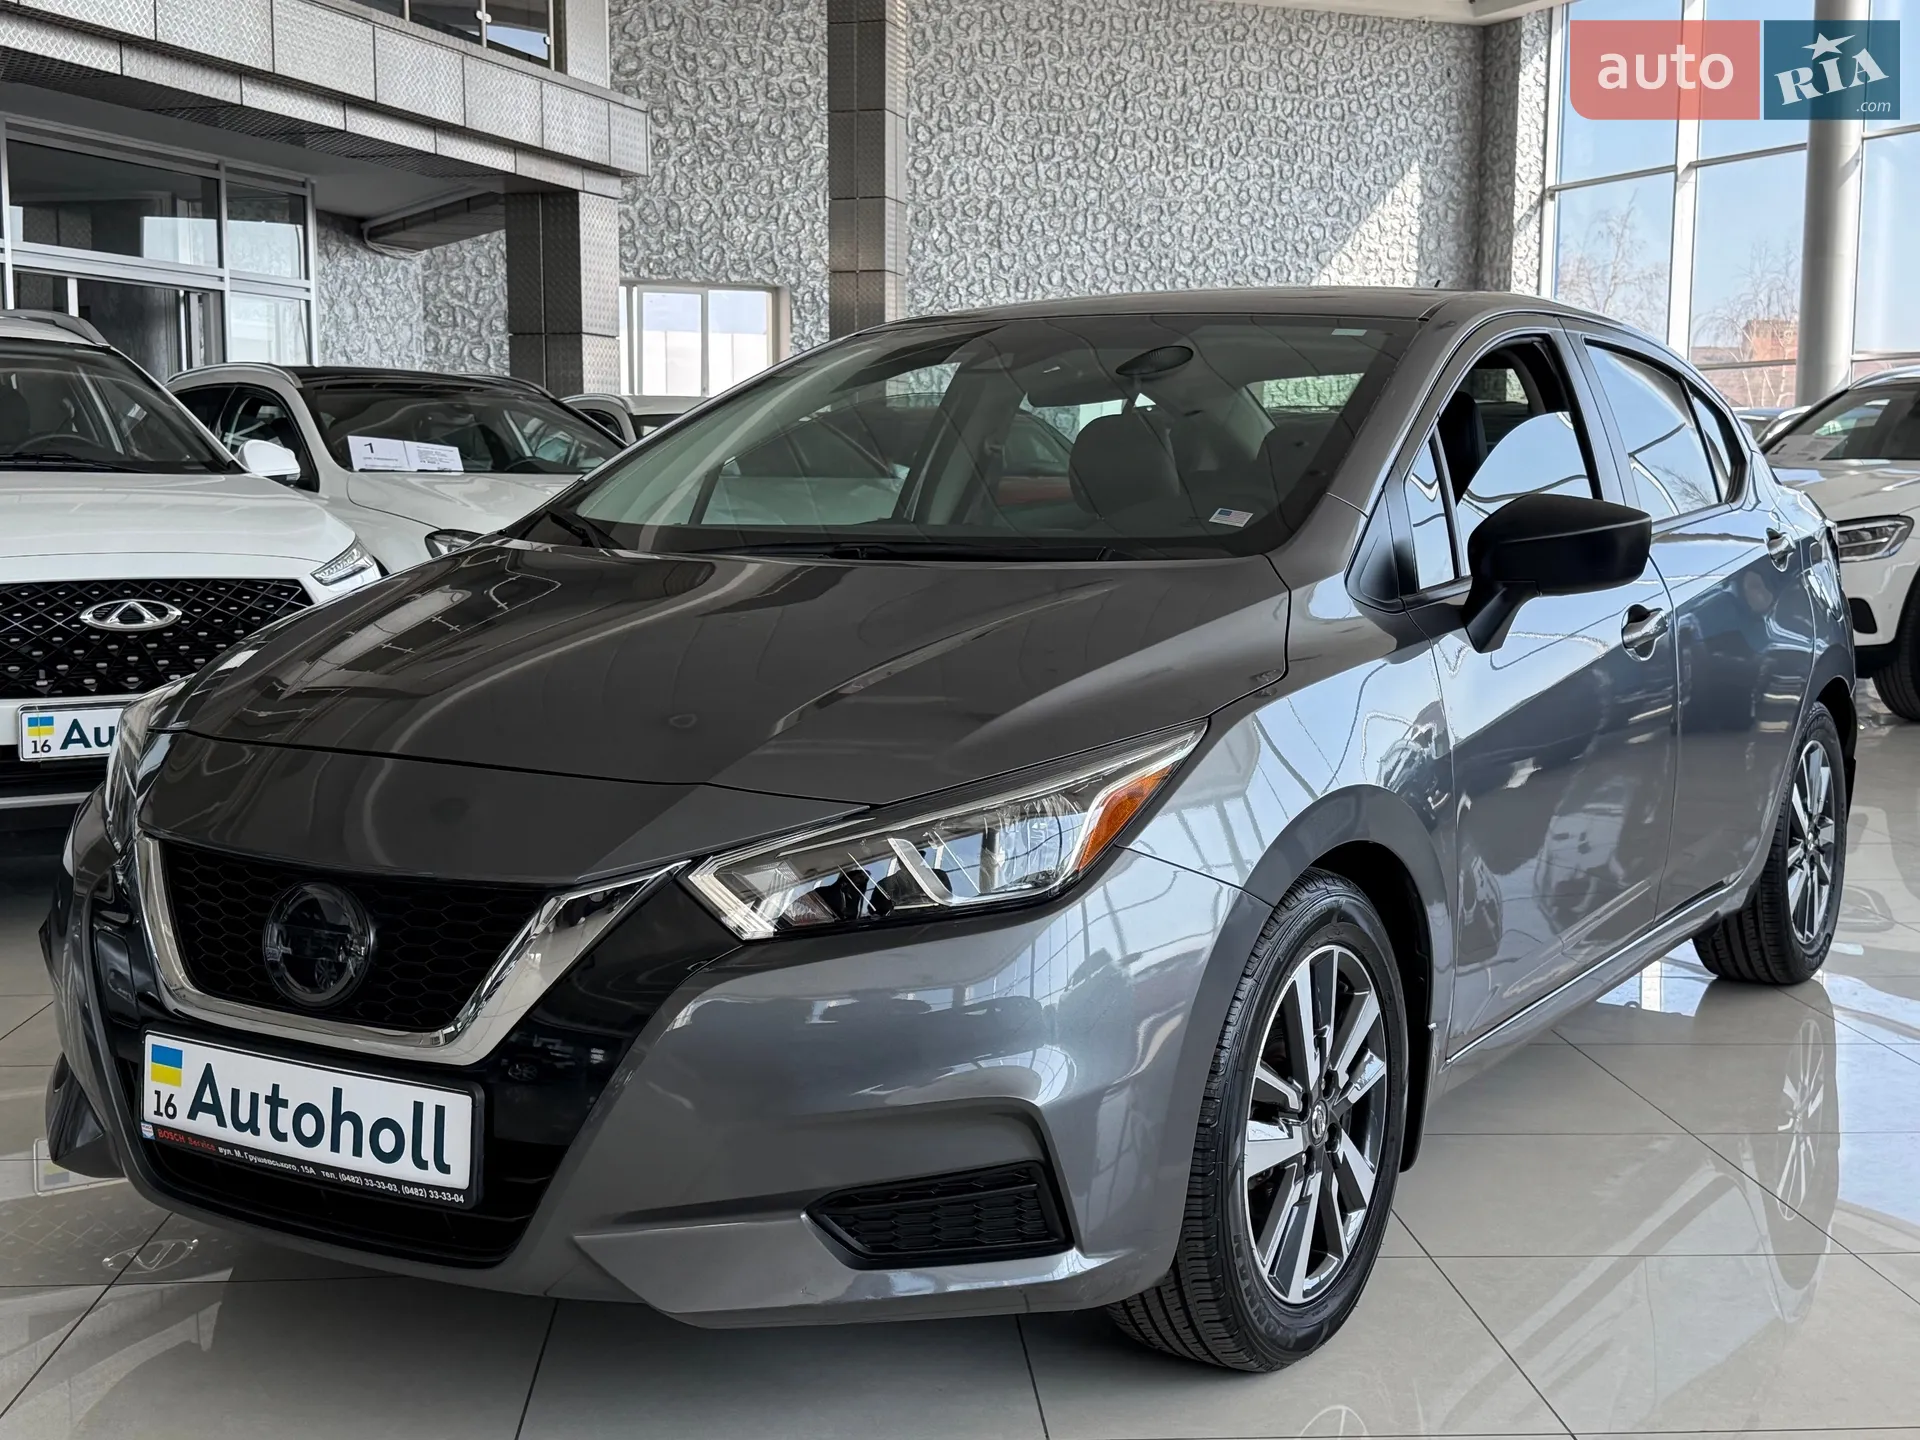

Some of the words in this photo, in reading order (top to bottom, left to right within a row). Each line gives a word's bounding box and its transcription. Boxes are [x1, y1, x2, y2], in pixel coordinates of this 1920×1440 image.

[364, 442, 374, 454] 1
[31, 740, 52, 754] 16
[153, 1089, 177, 1120] 16
[187, 1063, 451, 1175] Autoholl
[157, 1128, 185, 1143] BOSCH
[218, 1146, 233, 1156] вул.
[320, 1170, 338, 1180] тел.
[339, 1172, 363, 1186] (0482)
[401, 1184, 427, 1198] (0482)
[428, 1190, 465, 1203] 33-33-04
